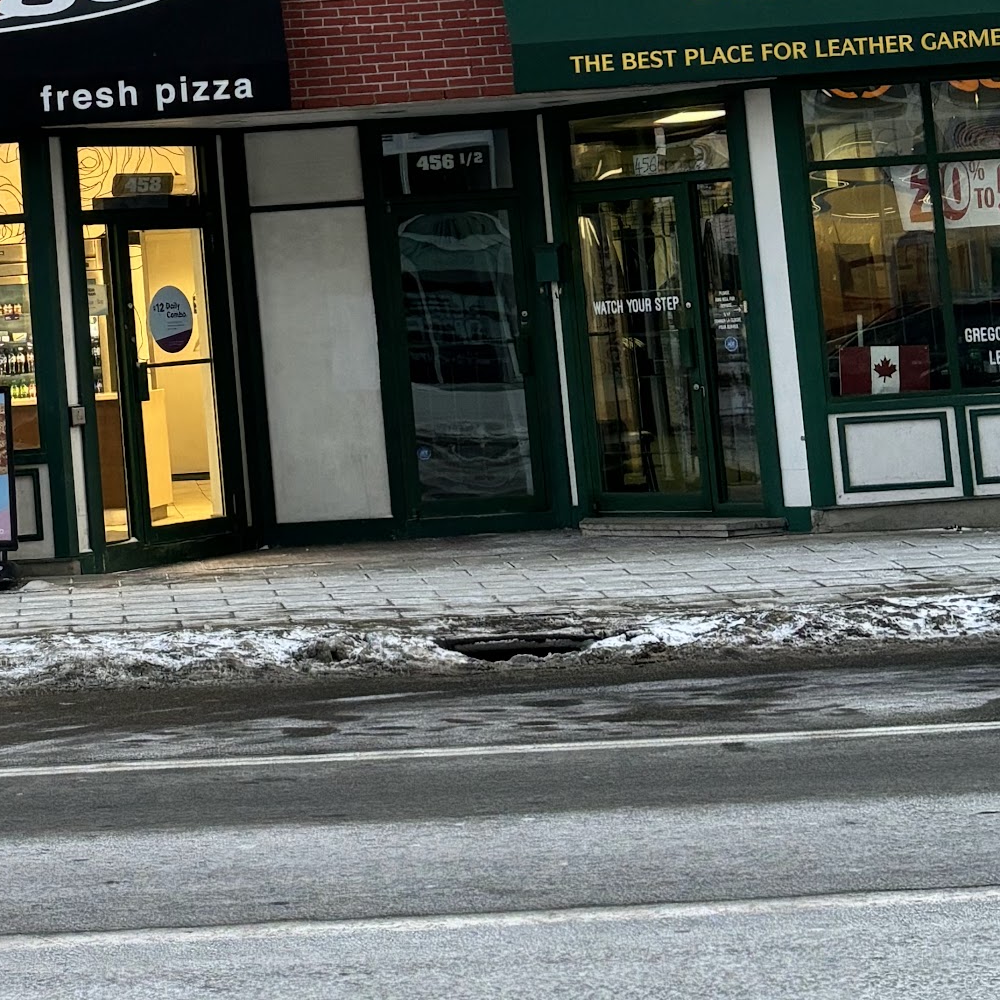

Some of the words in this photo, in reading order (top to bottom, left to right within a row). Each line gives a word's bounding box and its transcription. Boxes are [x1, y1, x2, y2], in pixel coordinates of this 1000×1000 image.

[569, 53, 614, 74] THE
[621, 49, 677, 71] BEST
[684, 44, 754, 67] PLACE
[761, 41, 808, 62] FOR
[815, 34, 914, 58] LEATHER
[920, 28, 1000, 51] GARME
[40, 80, 138, 112] fresh
[155, 75, 253, 111] pizza
[416, 153, 454, 171] 456
[459, 151, 484, 167] 1/2
[124, 176, 162, 193] 458
[974, 187, 995, 208] TO
[166, 302, 180, 310] Daily
[593, 299, 624, 315] WATCH
[626, 298, 652, 313] YOUR
[654, 296, 679, 312] STEP
[964, 326, 1000, 343] GREGO
